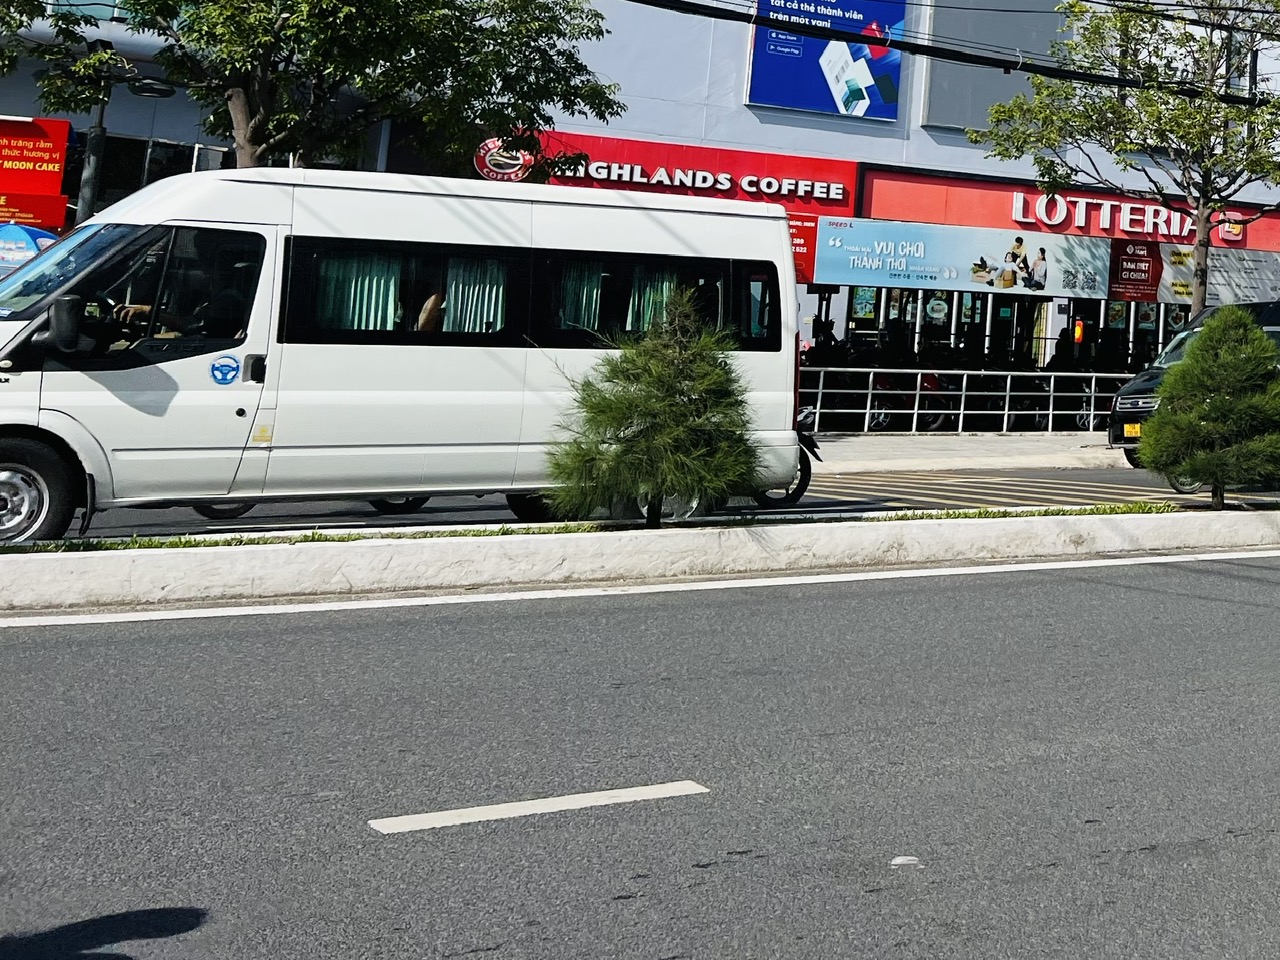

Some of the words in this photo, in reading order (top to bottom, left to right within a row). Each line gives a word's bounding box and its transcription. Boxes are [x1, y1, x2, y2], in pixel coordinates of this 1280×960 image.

[786, 0, 799, 10] cả
[799, 2, 816, 13] thẻ
[817, 5, 843, 18] thành
[844, 10, 864, 21] viên
[769, 11, 789, 22] trên
[811, 18, 831, 29] vani
[10, 139, 34, 149] trăng
[2, 148, 22, 157] thức
[23, 150, 50, 160] hương
[3, 160, 34, 170] MOON
[35, 162, 61, 172] CAKE
[740, 175, 844, 200] COFFEE
[874, 240, 895, 257] VUI
